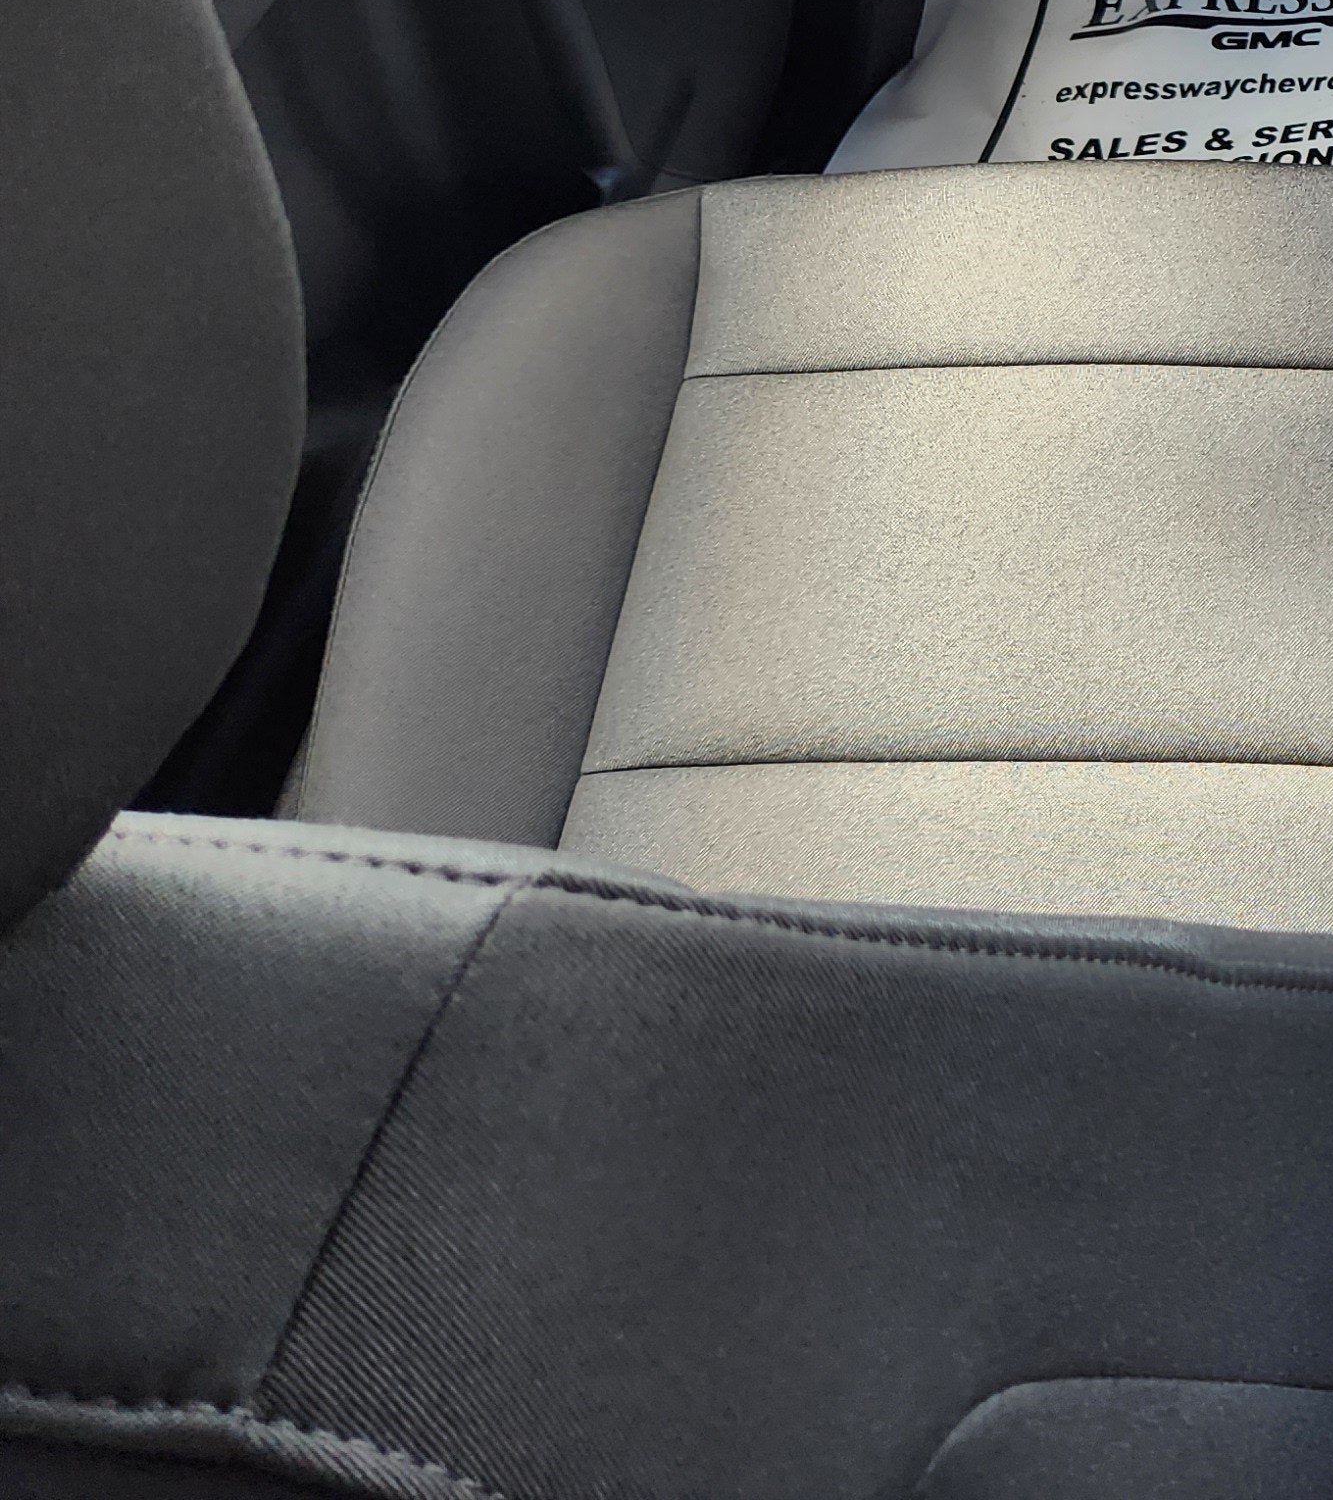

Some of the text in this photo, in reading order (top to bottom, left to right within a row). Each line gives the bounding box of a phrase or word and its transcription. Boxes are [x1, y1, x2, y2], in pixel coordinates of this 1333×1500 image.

[1211, 28, 1323, 51] GMC
[1048, 130, 1188, 161] SALES
[1204, 127, 1235, 152] &
